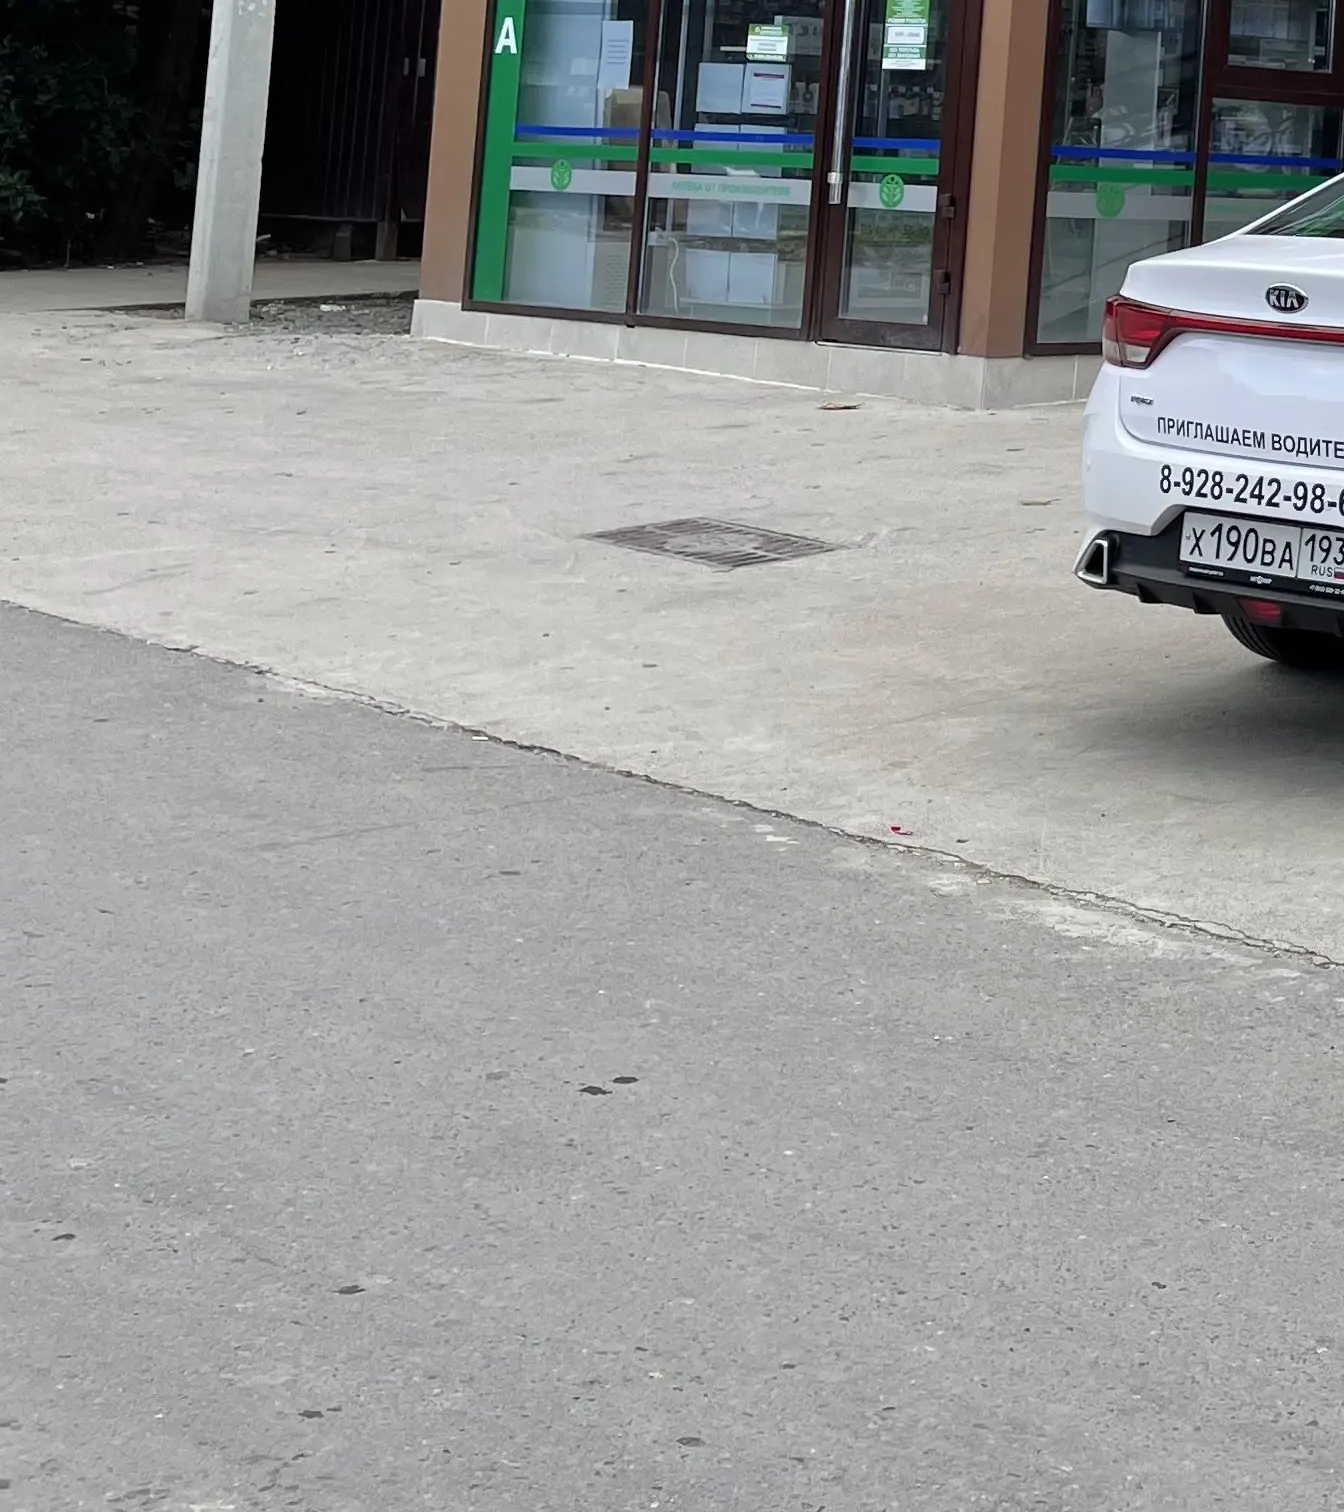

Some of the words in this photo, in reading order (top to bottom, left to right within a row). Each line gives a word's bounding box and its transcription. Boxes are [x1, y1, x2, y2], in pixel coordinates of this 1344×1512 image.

[1269, 289, 1299, 309] KIA
[1157, 416, 1265, 449] ПРИГЛАШАЕМ
[1311, 564, 1333, 578] RUS
